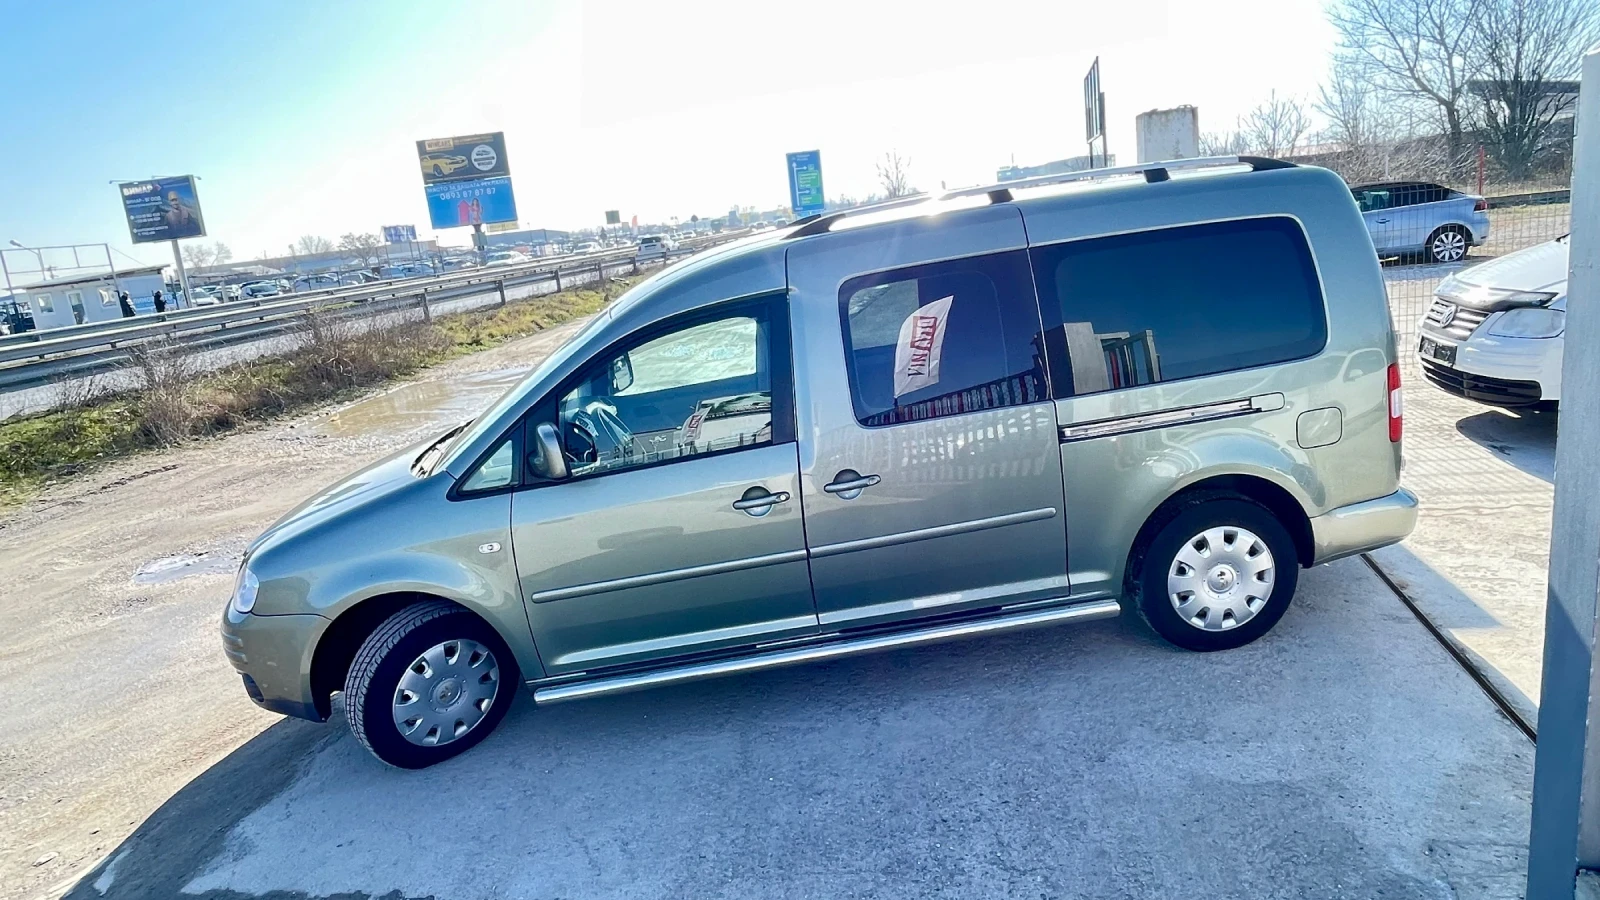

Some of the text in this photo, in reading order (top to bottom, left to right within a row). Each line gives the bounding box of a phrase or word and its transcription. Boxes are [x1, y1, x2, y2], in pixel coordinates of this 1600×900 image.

[123, 185, 154, 196] ВИМАР
[440, 187, 496, 201] 0893 87 87 87
[907, 353, 928, 377] VIN
